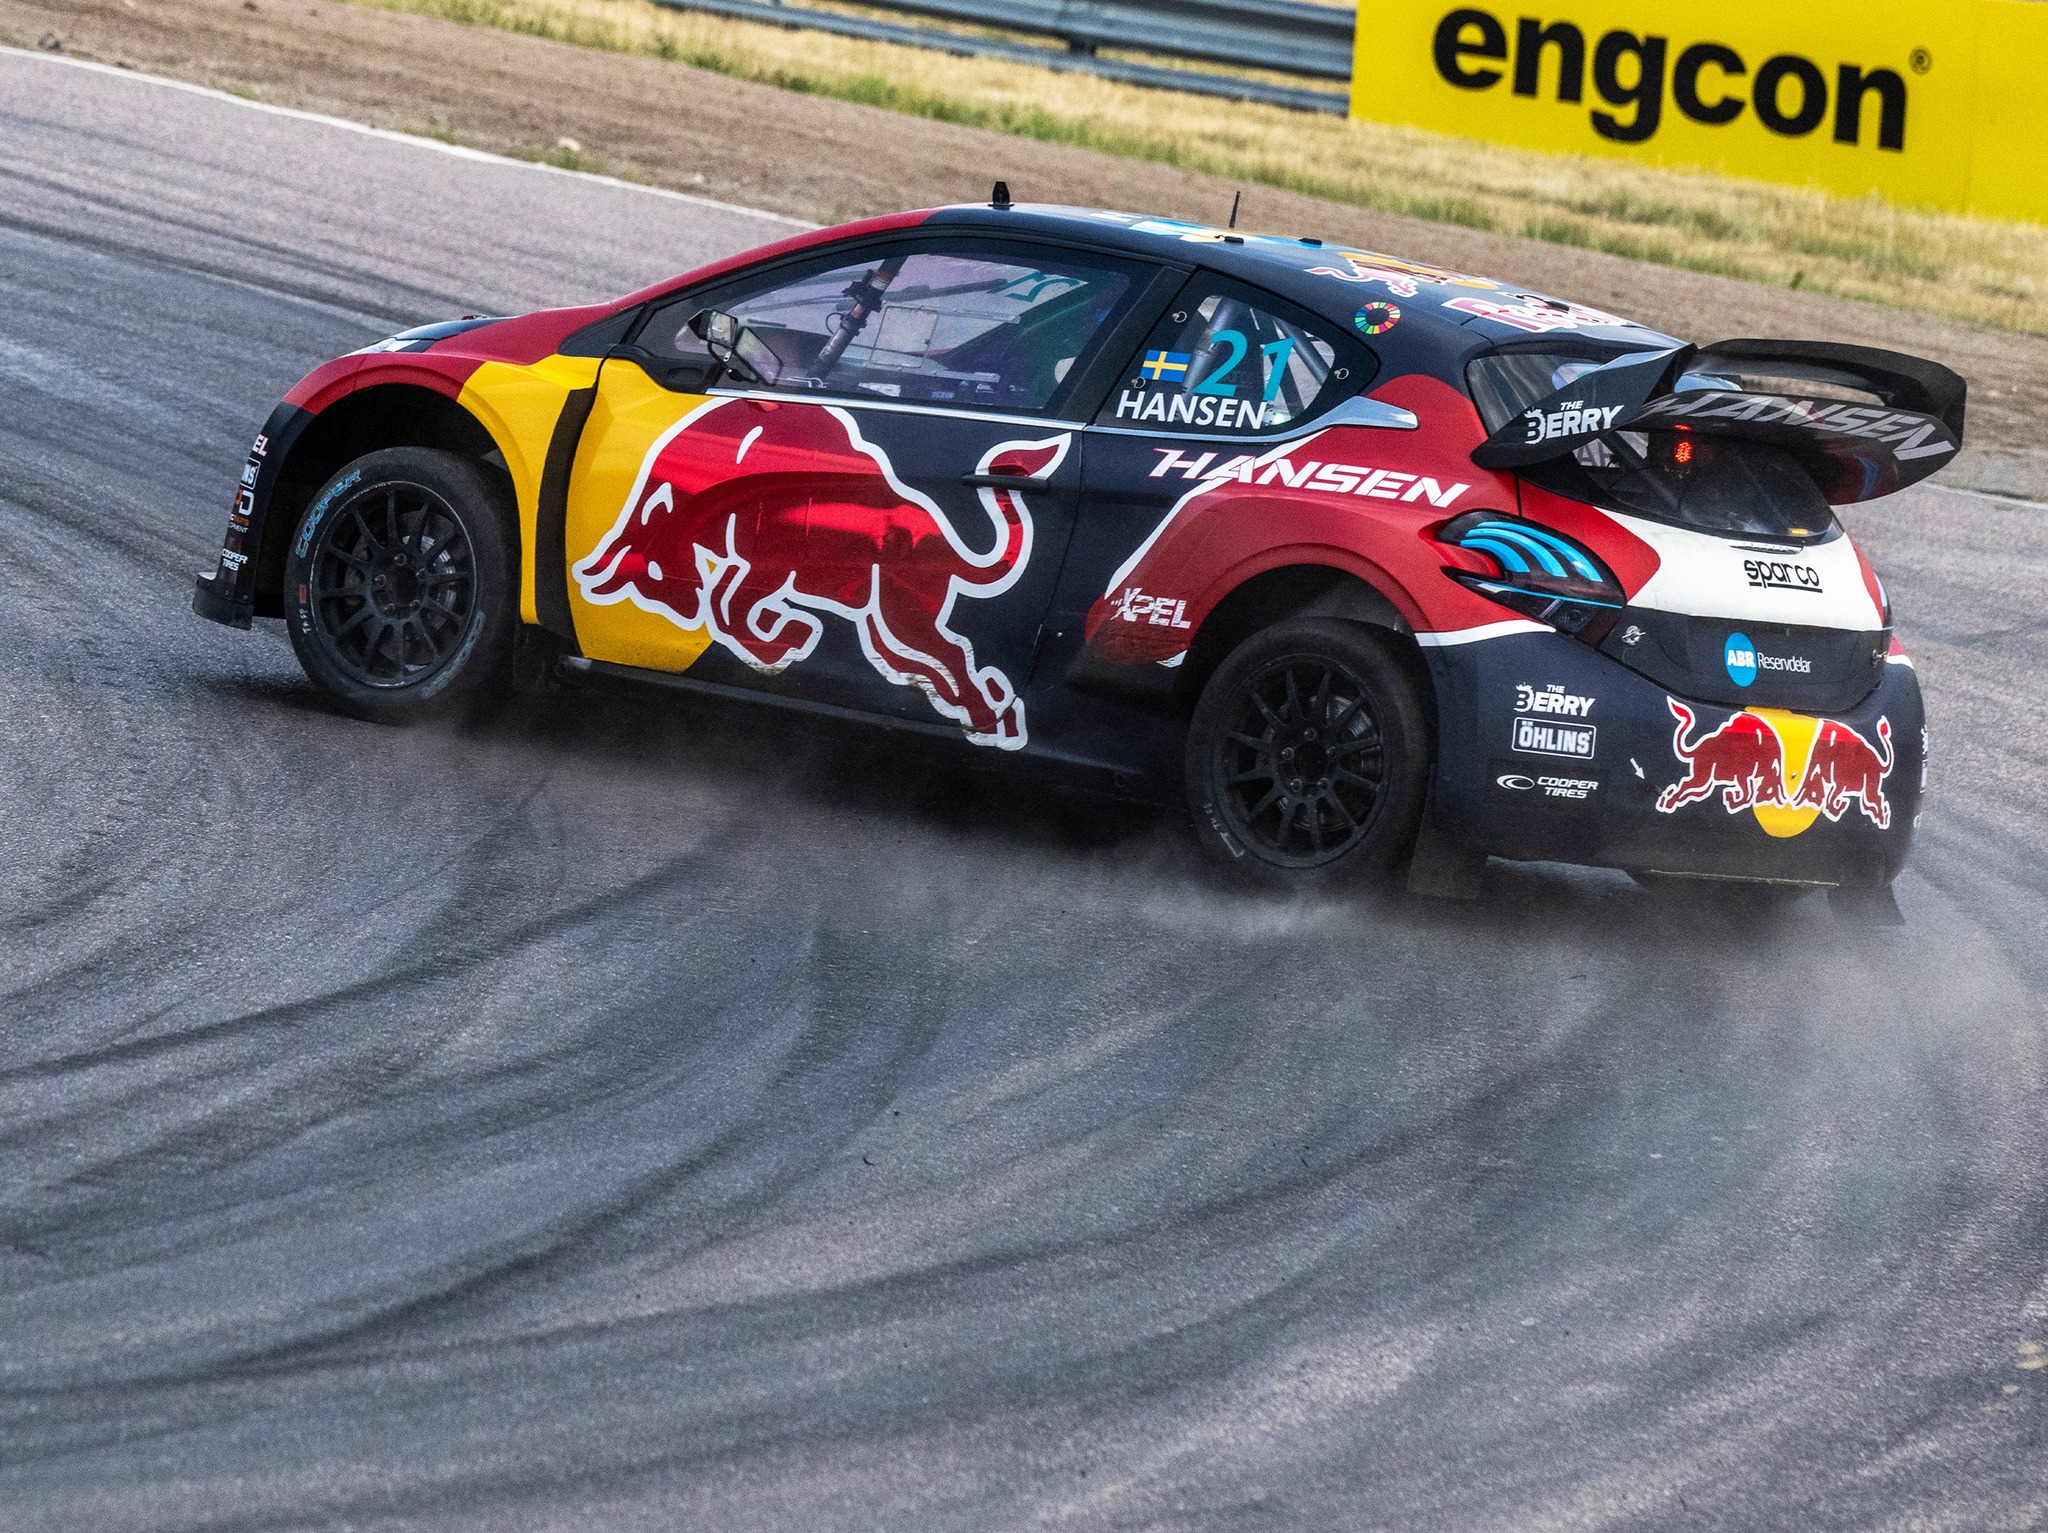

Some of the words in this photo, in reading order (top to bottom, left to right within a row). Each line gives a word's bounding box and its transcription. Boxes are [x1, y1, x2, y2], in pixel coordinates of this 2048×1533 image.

[1433, 7, 1908, 153] engcon
[1192, 328, 1296, 402] 21
[1115, 390, 1268, 430] HANSEN
[1560, 400, 1584, 411] THE
[1523, 405, 1625, 445] BERRY
[1640, 392, 1955, 461] HANSEN
[1149, 447, 1471, 509] HANSEN
[222, 548, 248, 564] COOPER
[222, 558, 240, 571] TIRES
[1743, 559, 1820, 589] sparco
[1110, 587, 1191, 629] XPEL
[1727, 649, 1756, 668] ABR
[1757, 652, 1812, 673] Reservdelar
[1513, 682, 1596, 717] BERRY
[1546, 684, 1565, 693] THE
[1518, 720, 1593, 754] ÖHLINS
[1537, 776, 1599, 790] COOPER
[1544, 787, 1588, 799] TIRES
